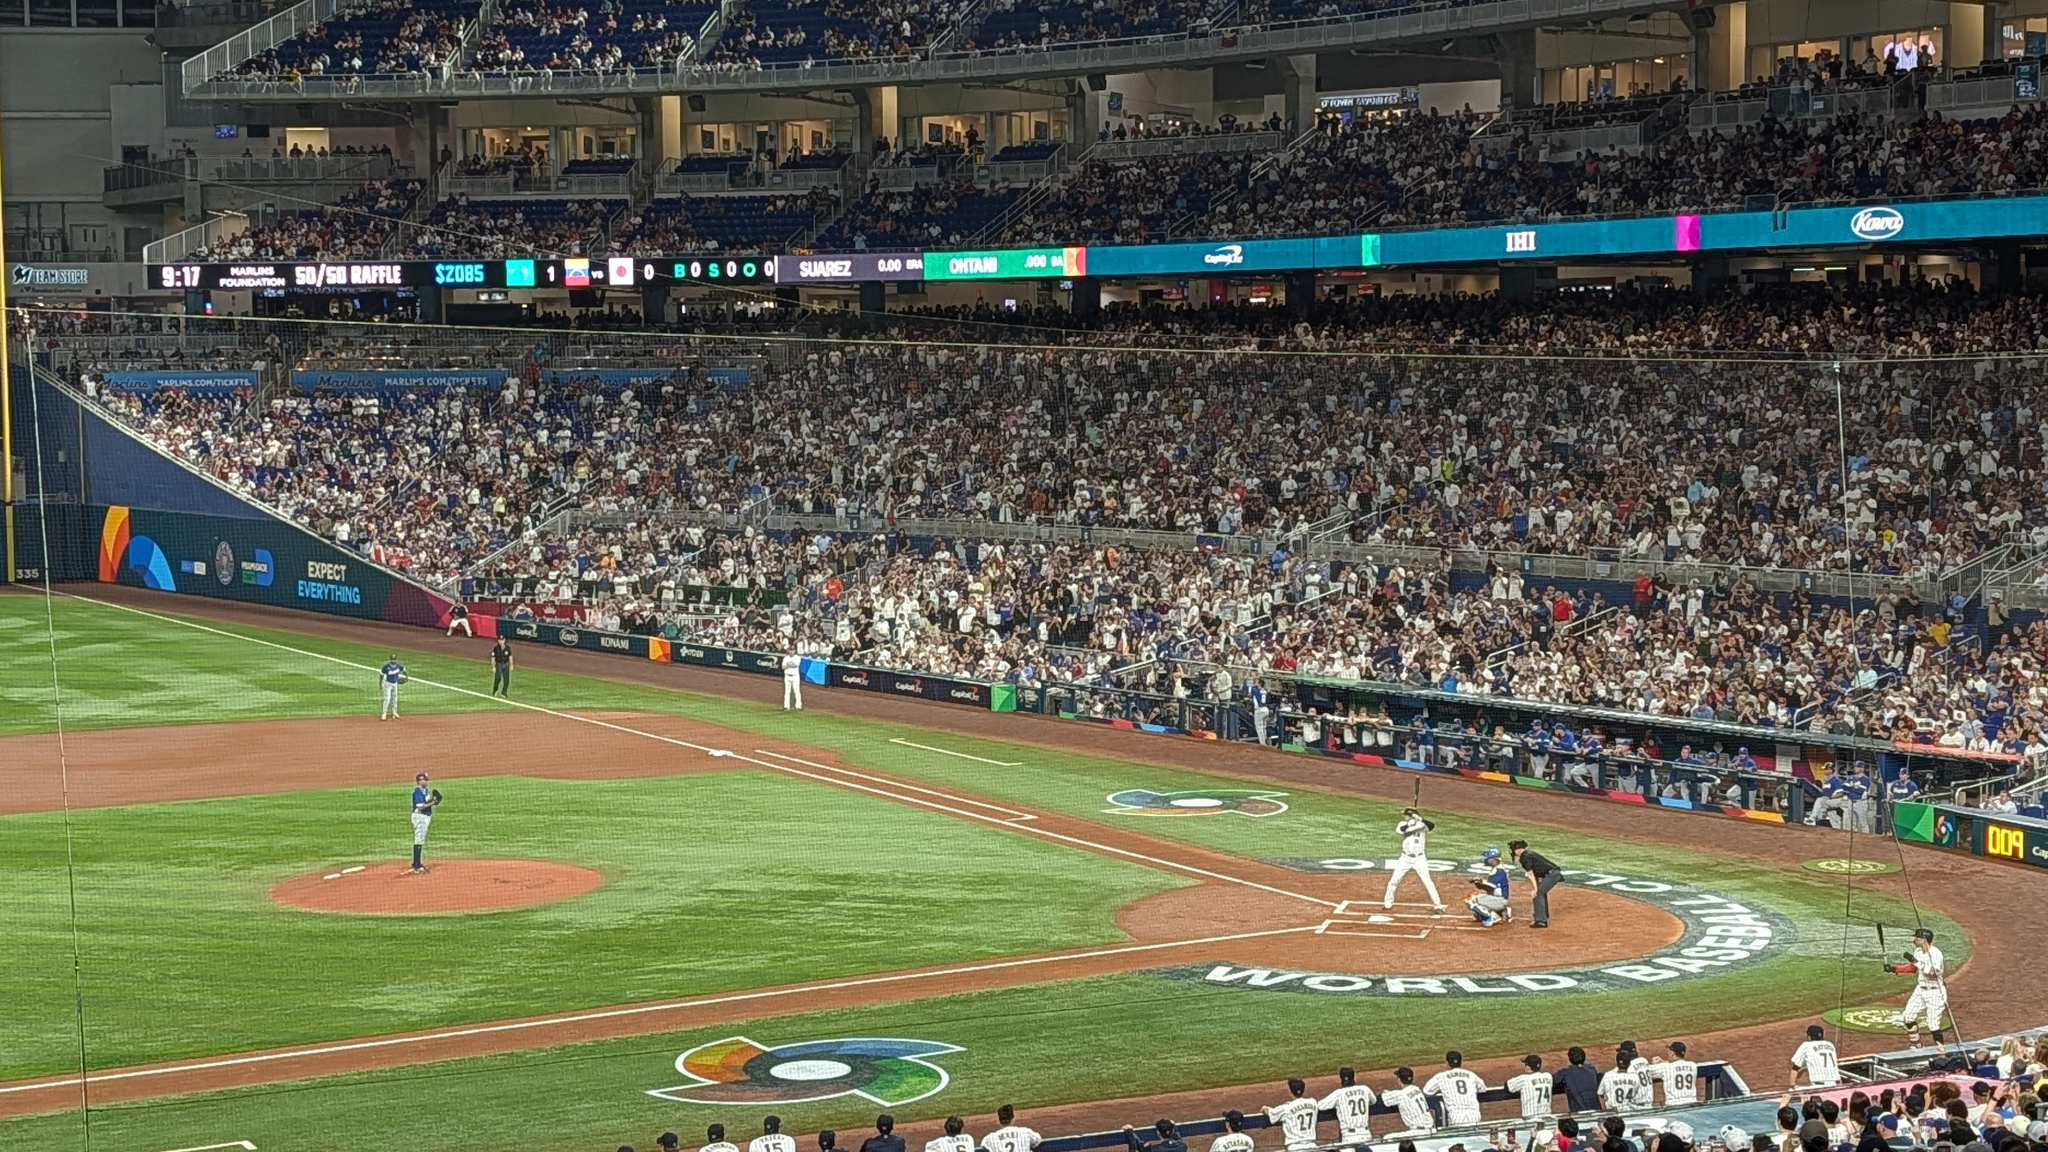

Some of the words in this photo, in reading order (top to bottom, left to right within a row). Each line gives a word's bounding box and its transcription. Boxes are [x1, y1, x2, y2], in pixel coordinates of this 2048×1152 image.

[1855, 212, 1900, 232] Kowa
[1506, 231, 1536, 252] IHI
[674, 263, 686, 278] B
[690, 261, 701, 277] 0
[708, 263, 720, 278] S
[726, 261, 737, 278] 0
[764, 260, 774, 277] 0
[799, 260, 852, 278] SUAREZ
[878, 259, 902, 272] 0.00
[906, 259, 923, 270] ERA
[949, 257, 998, 274] OHTANI
[1024, 255, 1047, 268] .000
[33, 269, 58, 285] TEAM
[59, 269, 88, 284] STORE
[162, 266, 201, 288] 9:17
[230, 266, 275, 276] MARLINS
[295, 263, 347, 287] 50/50
[351, 265, 402, 284] RAFFLE
[435, 263, 485, 285] $2085
[547, 265, 555, 282] 1
[643, 264, 655, 280] 0
[219, 278, 286, 288] FOUNDATION
[16, 568, 40, 579] 335
[308, 561, 347, 581] EXPECT
[298, 580, 361, 604] EVERYTHING
[600, 637, 629, 650] KONAMI
[1988, 826, 2024, 859] 009
[1204, 965, 1579, 994] WORLD
[1601, 894, 1773, 982] BASEBALL
[1819, 1052, 1836, 1068] 71
[1455, 1079, 1467, 1095] 8
[1675, 1073, 1693, 1090] 89
[1535, 1086, 1550, 1104] 74
[1615, 1087, 1634, 1104] 84
[1348, 1098, 1367, 1117] 20
[1297, 1112, 1314, 1132] 27
